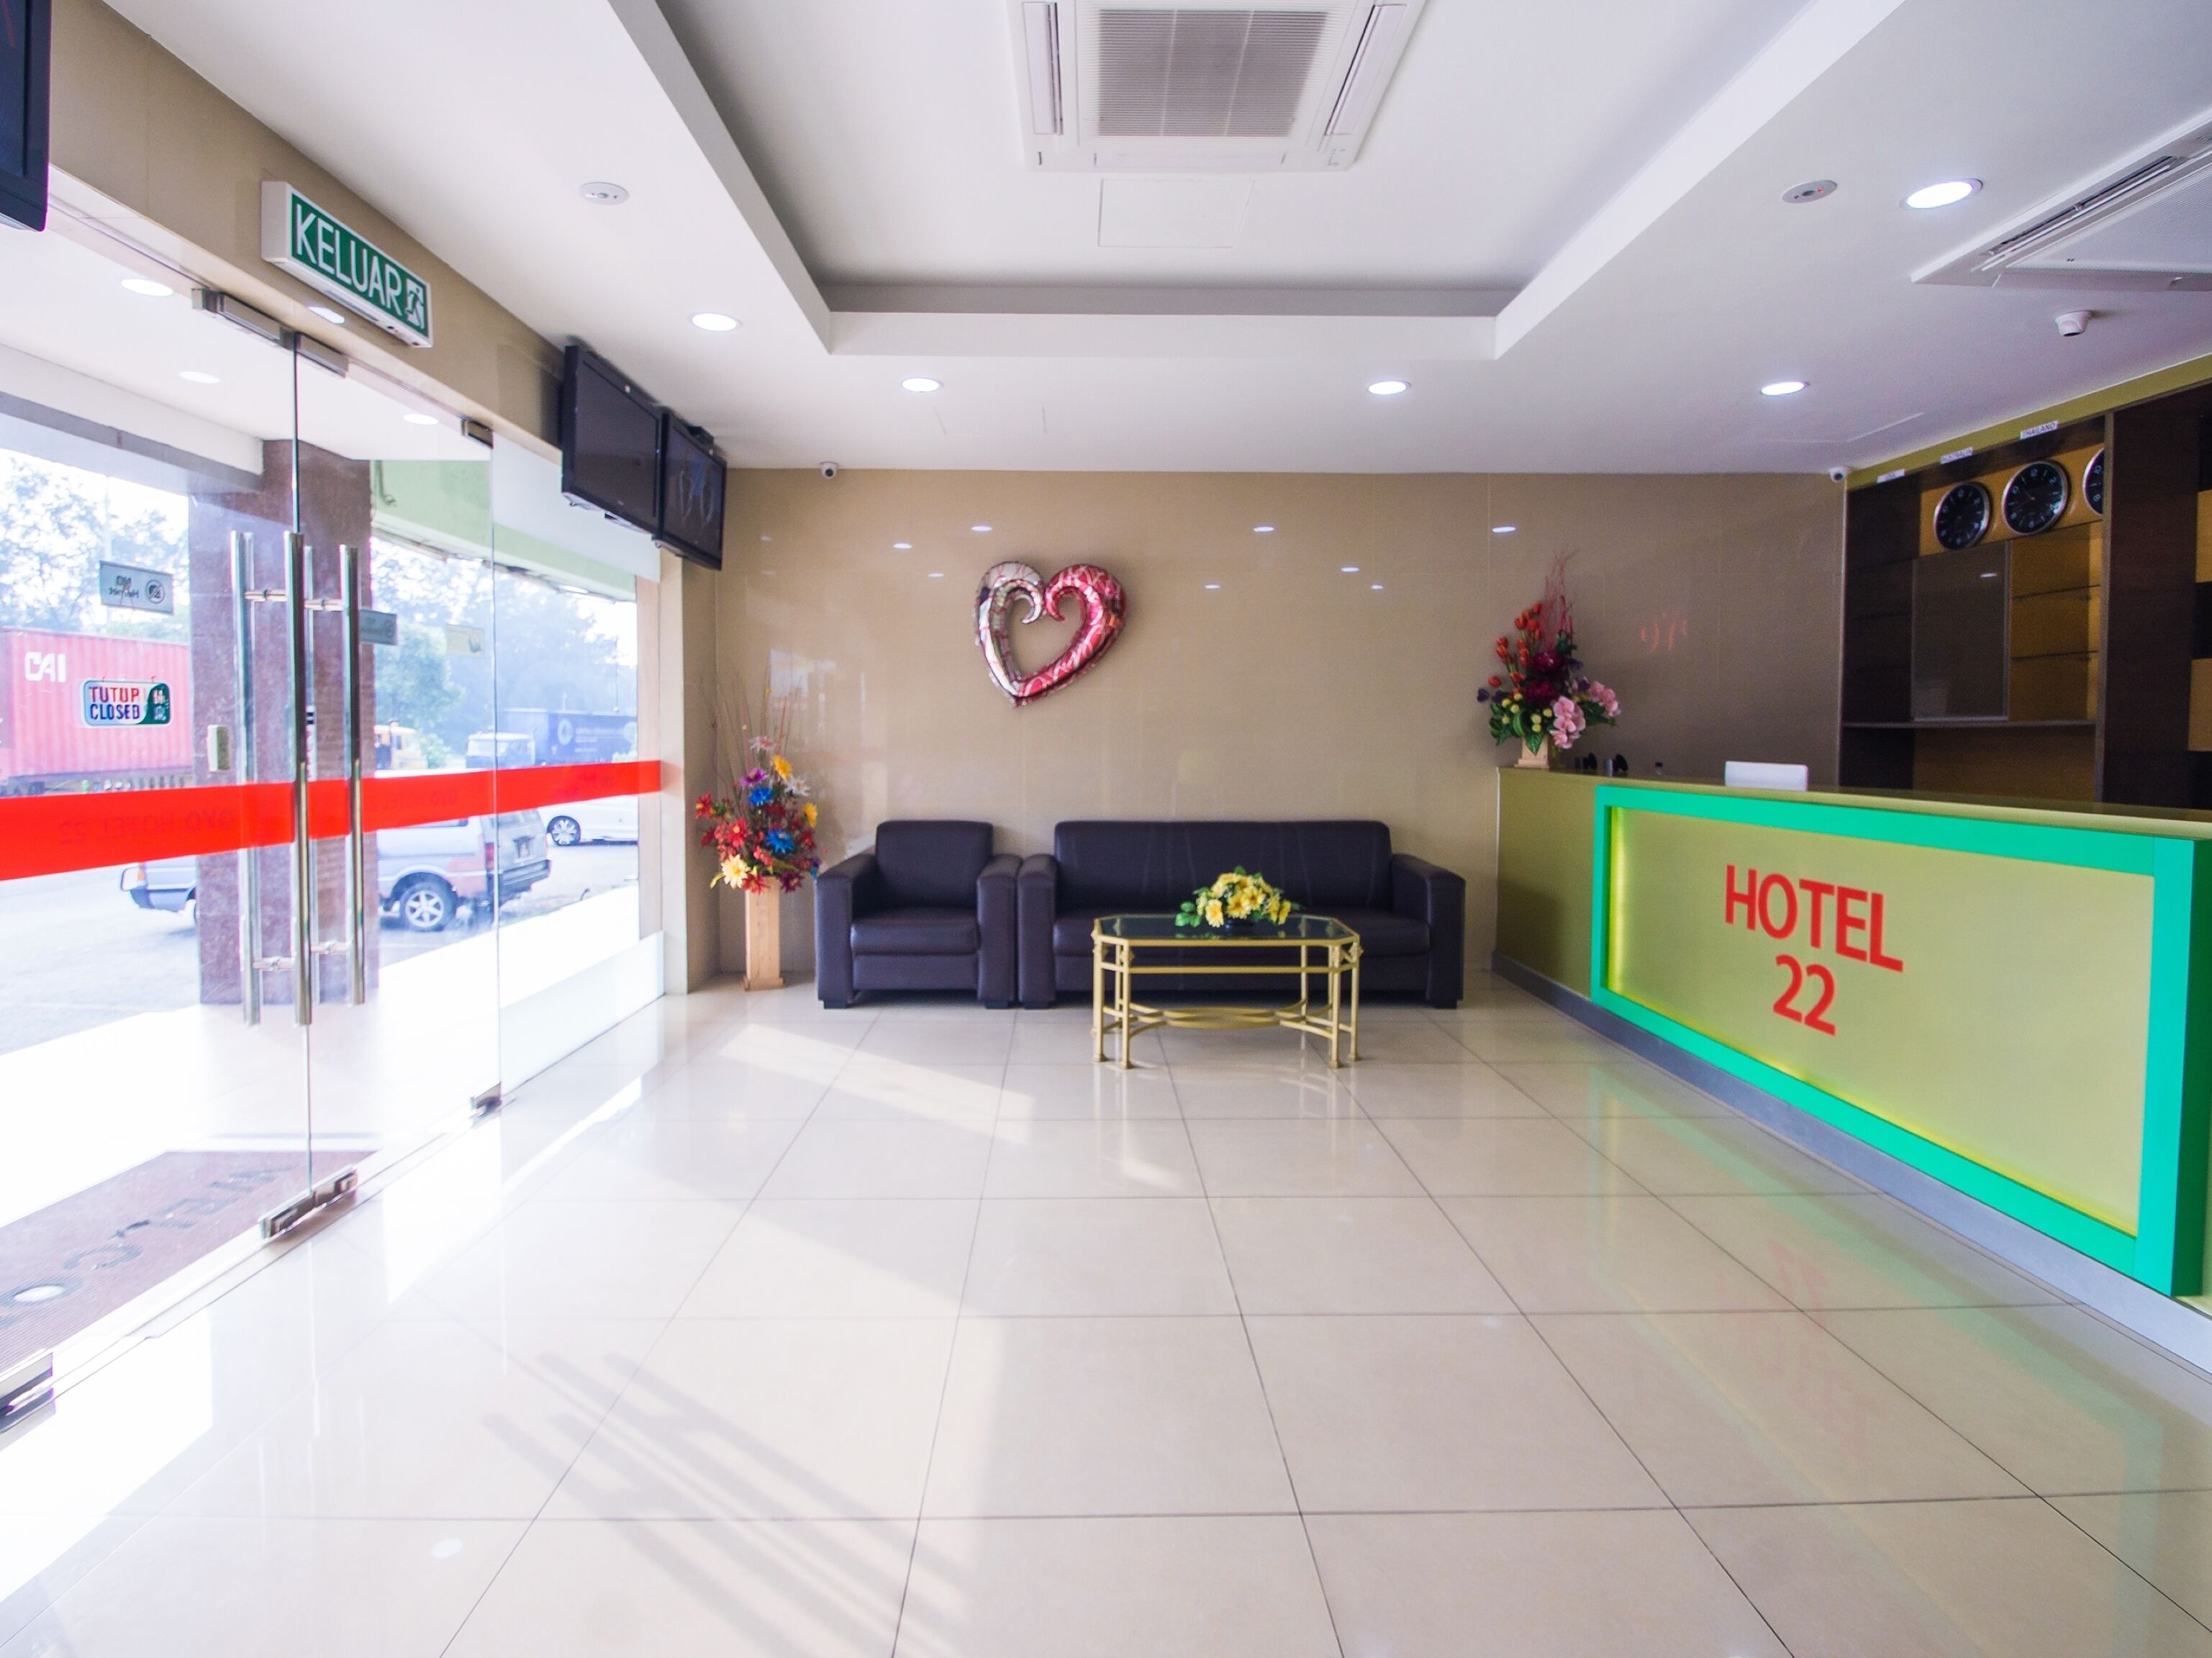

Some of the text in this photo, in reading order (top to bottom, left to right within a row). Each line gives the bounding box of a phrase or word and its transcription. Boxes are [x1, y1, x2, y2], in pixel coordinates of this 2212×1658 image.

[296, 203, 402, 316] KELUAR
[25, 652, 66, 683] CAI
[89, 687, 140, 702] TUTUP
[90, 704, 140, 720] CLOSED
[1725, 864, 1904, 974] HOTEL
[1772, 954, 1836, 1037] 22
